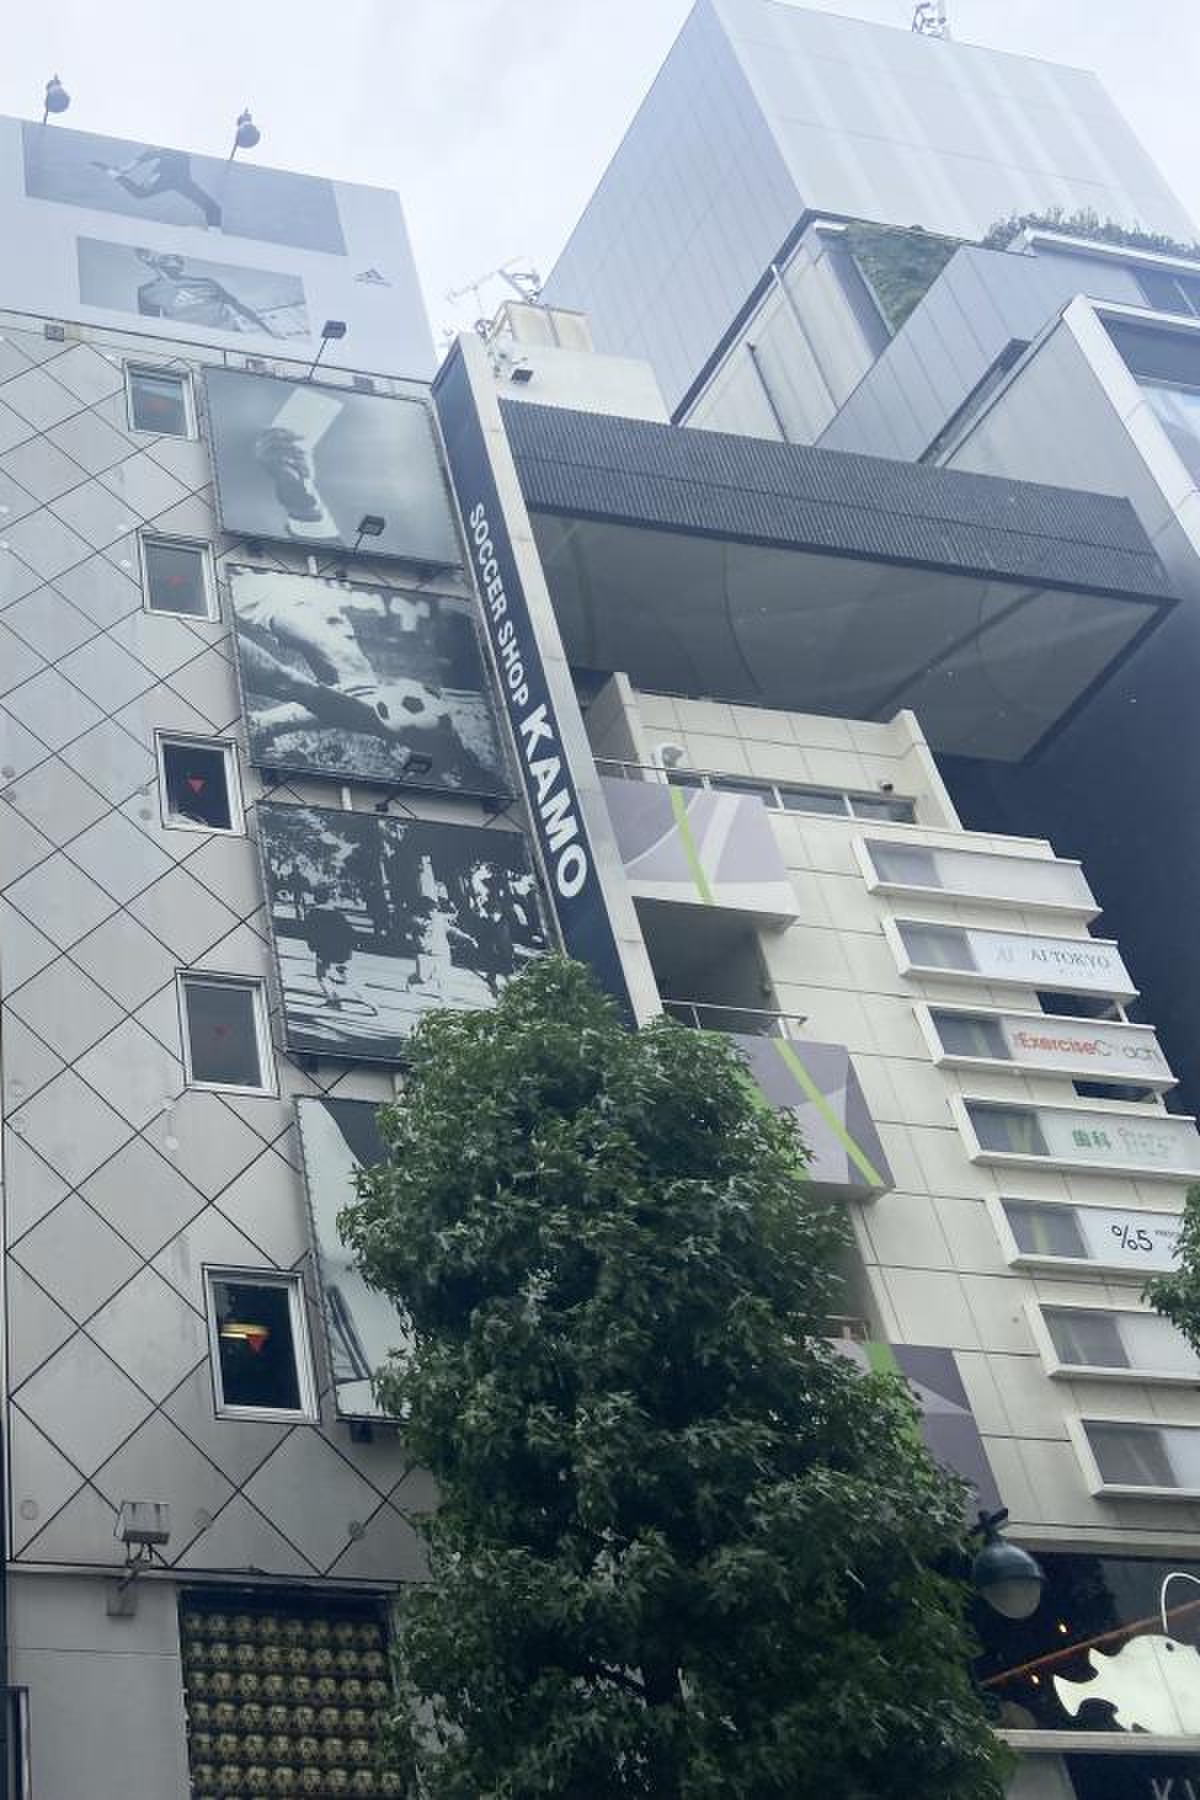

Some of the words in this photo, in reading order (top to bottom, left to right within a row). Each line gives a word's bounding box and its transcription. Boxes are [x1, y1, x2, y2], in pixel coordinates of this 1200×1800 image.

[469, 503, 507, 624] SOCCER
[498, 625, 529, 707] SHOP
[520, 704, 587, 898] KAMO
[1111, 1225, 1153, 1251] %5
